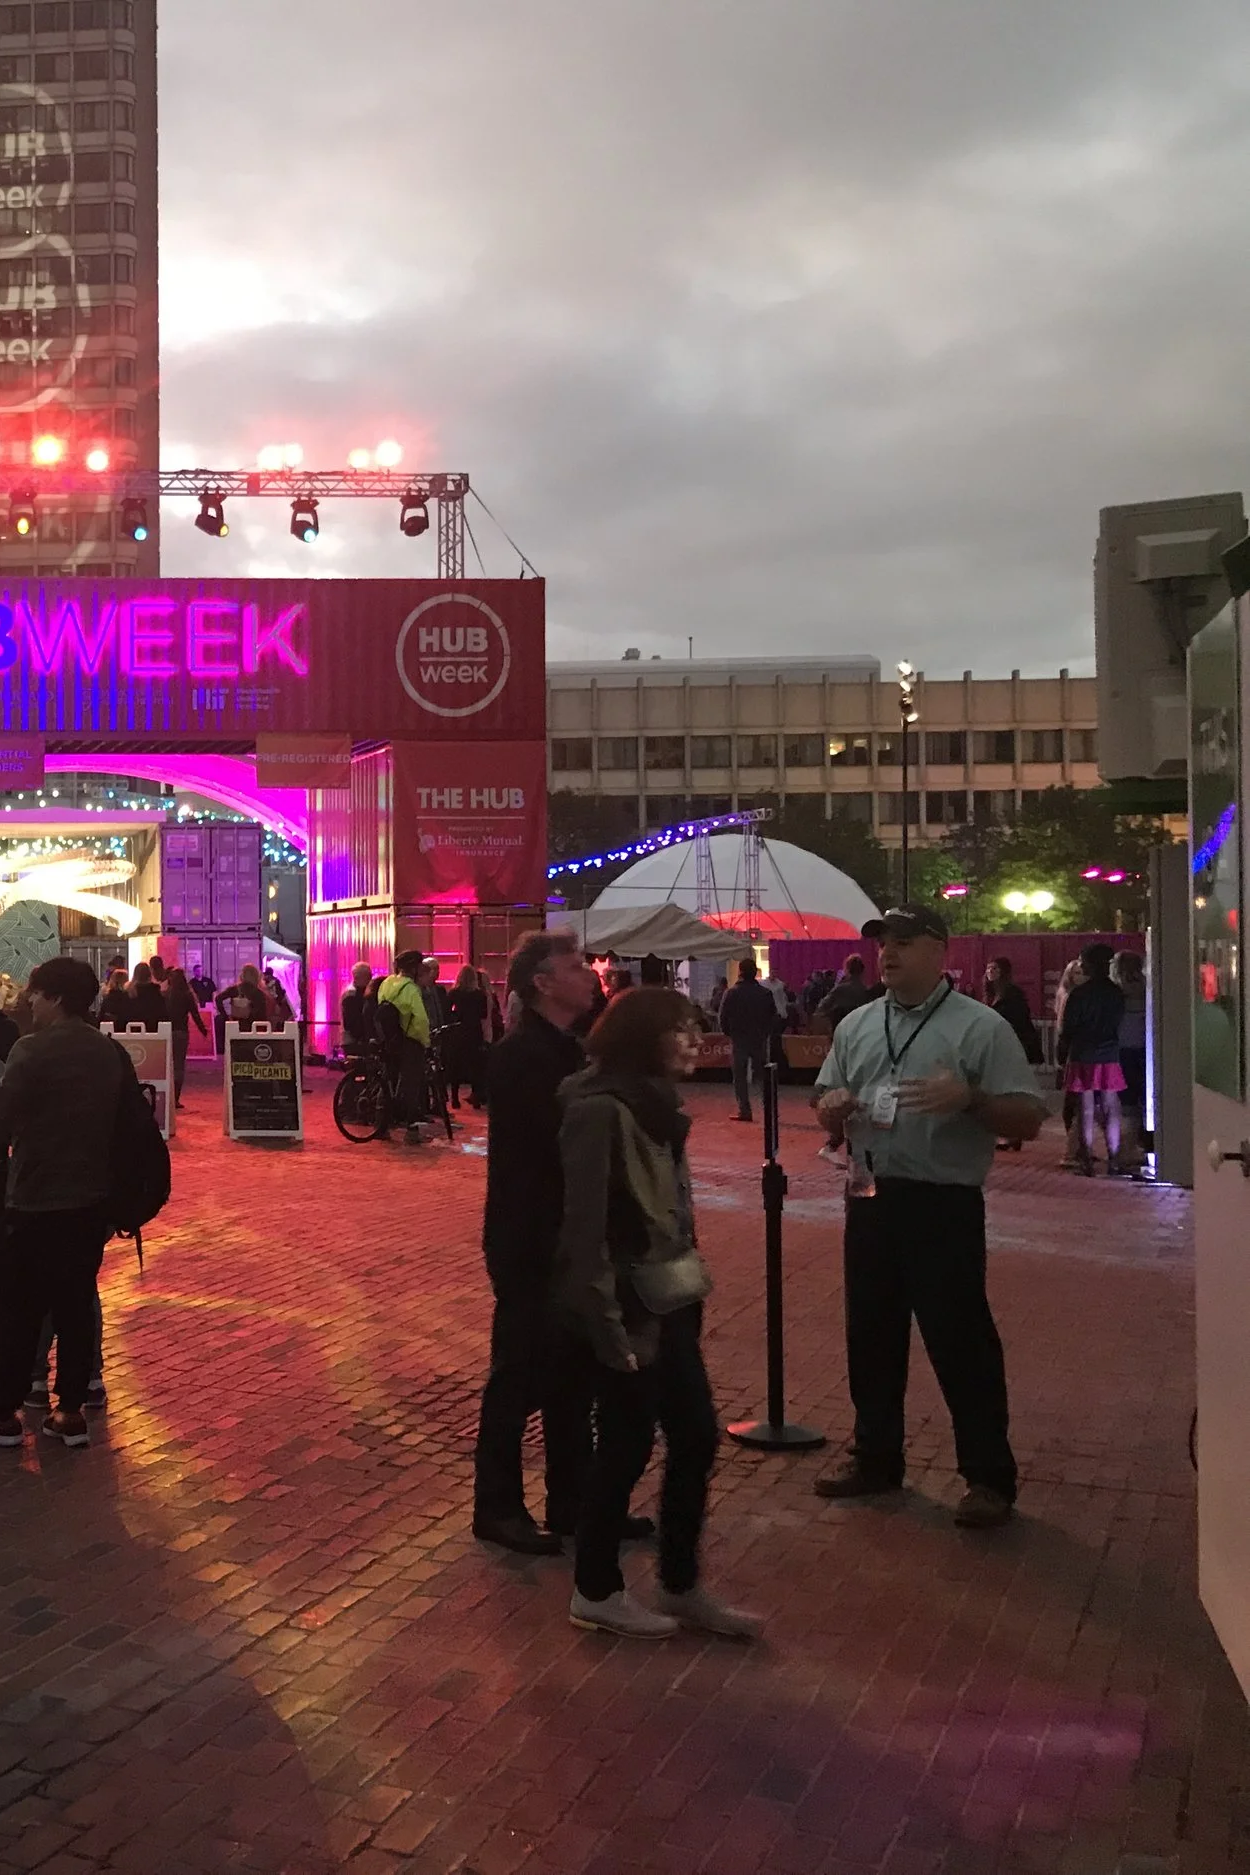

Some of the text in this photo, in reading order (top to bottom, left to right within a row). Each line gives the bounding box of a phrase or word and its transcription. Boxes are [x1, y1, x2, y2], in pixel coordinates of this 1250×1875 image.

[418, 627, 489, 653] HUB
[419, 664, 489, 684] week
[416, 787, 525, 809] THE HUB
[437, 835, 477, 849] Liberty
[234, 1063, 253, 1075] PICO
[254, 1067, 289, 1078] PICANTE
